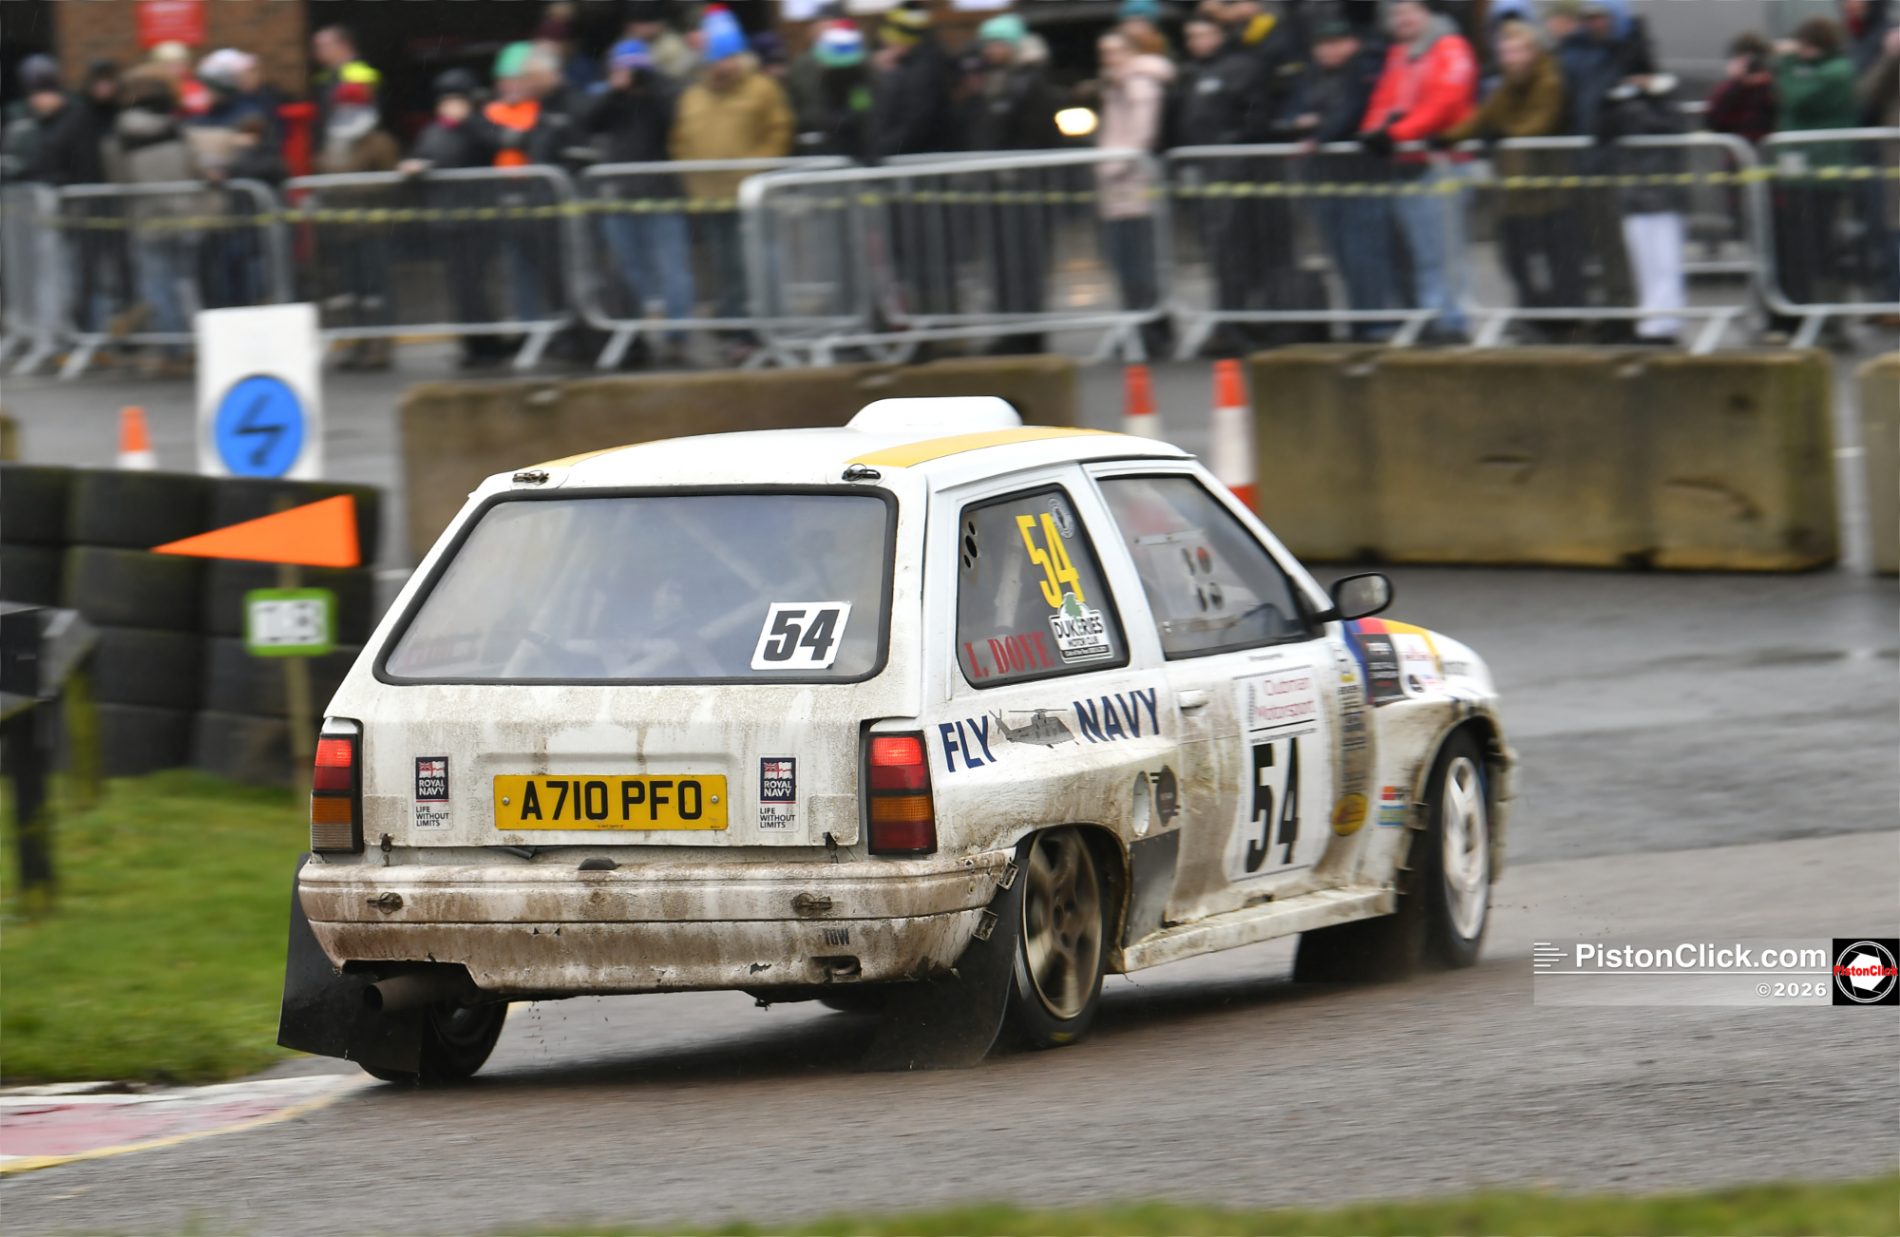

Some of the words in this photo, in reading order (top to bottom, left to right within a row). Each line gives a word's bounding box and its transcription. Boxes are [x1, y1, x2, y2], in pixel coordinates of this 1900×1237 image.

[1016, 512, 1086, 608] 54
[1053, 616, 1104, 638] DUKERIES
[763, 609, 840, 661] 54
[988, 631, 1055, 675] DOVE
[938, 715, 997, 773] FLY
[1073, 687, 1160, 744] NAVY
[418, 780, 446, 788] ROYAL
[763, 781, 792, 789] ROYAL
[419, 787, 445, 796] NAVY
[763, 788, 792, 797] NAVY
[520, 780, 609, 821] A710
[621, 780, 703, 821] PFO
[1244, 737, 1300, 873] 54
[760, 807, 776, 815] LIFE
[415, 812, 449, 820] WITHOUT
[760, 814, 796, 822] WITHOUT
[760, 821, 786, 829] LIMITS
